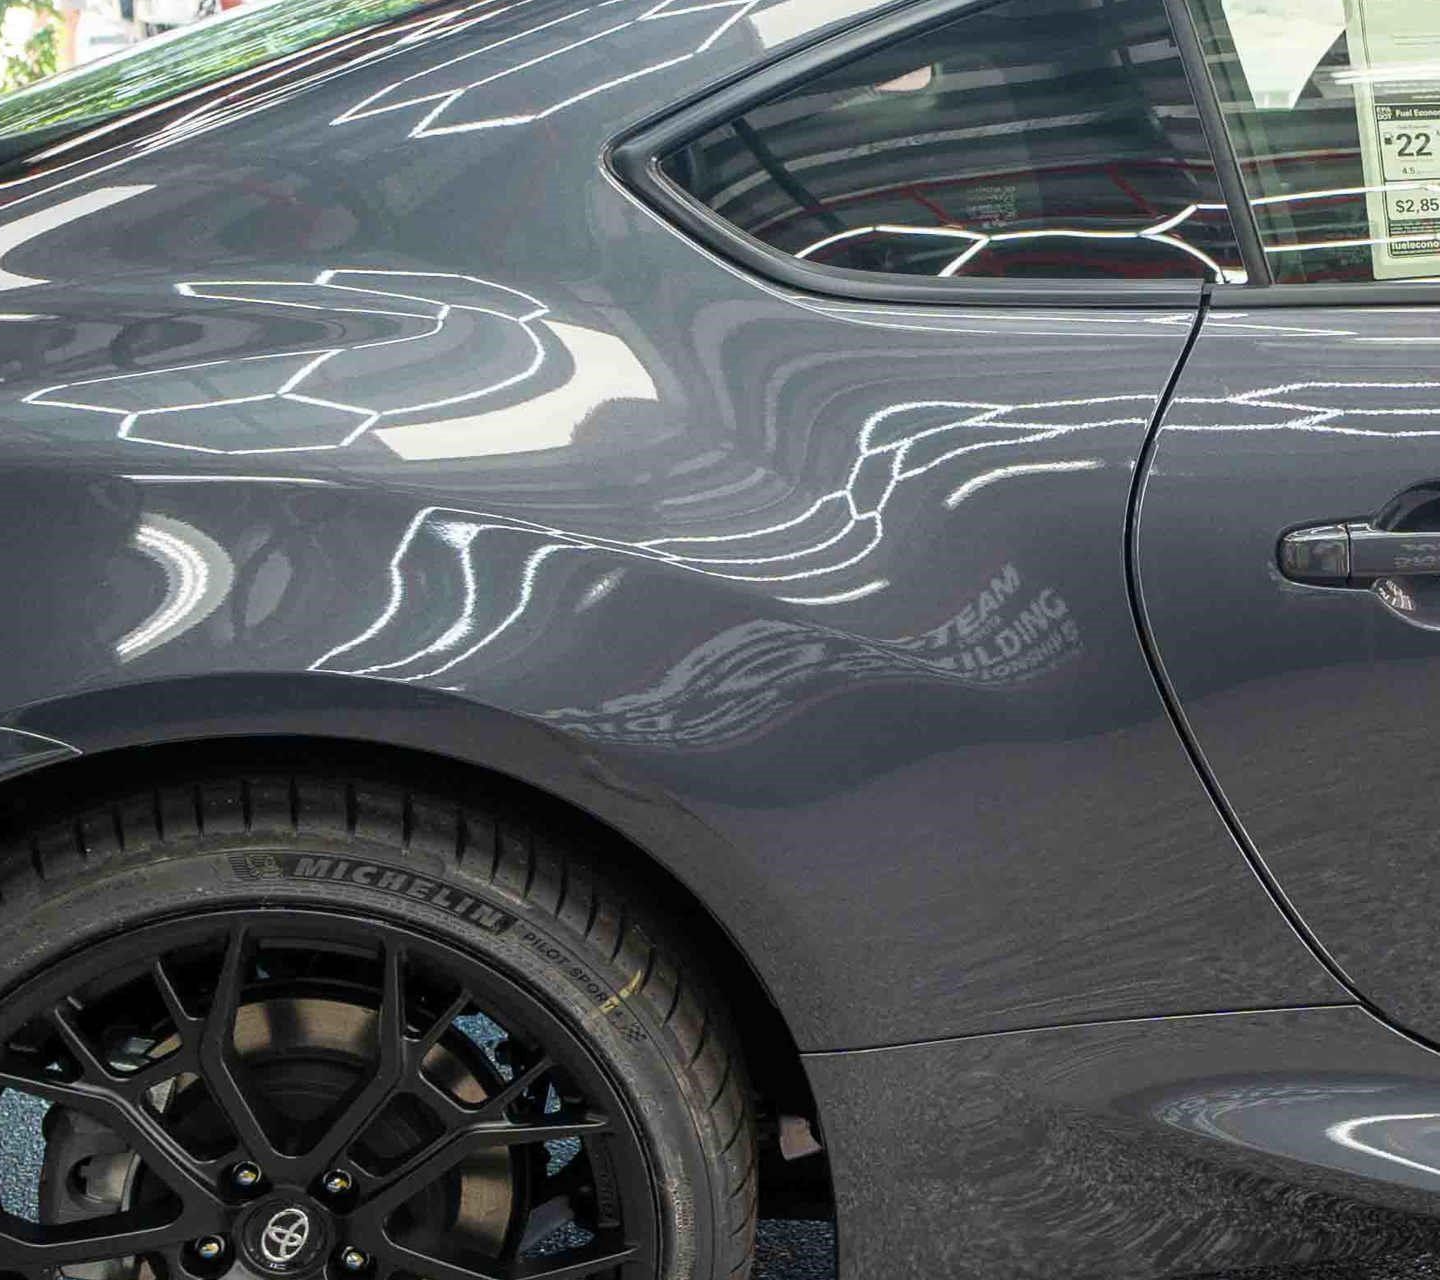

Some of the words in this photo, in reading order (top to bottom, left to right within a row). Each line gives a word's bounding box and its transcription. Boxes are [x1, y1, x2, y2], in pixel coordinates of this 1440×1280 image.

[1396, 108, 1412, 118] Fuel
[1395, 133, 1432, 157] 22
[292, 857, 507, 933] MICHELIN
[523, 931, 571, 964] PILOT
[569, 967, 618, 1010] SPORT
